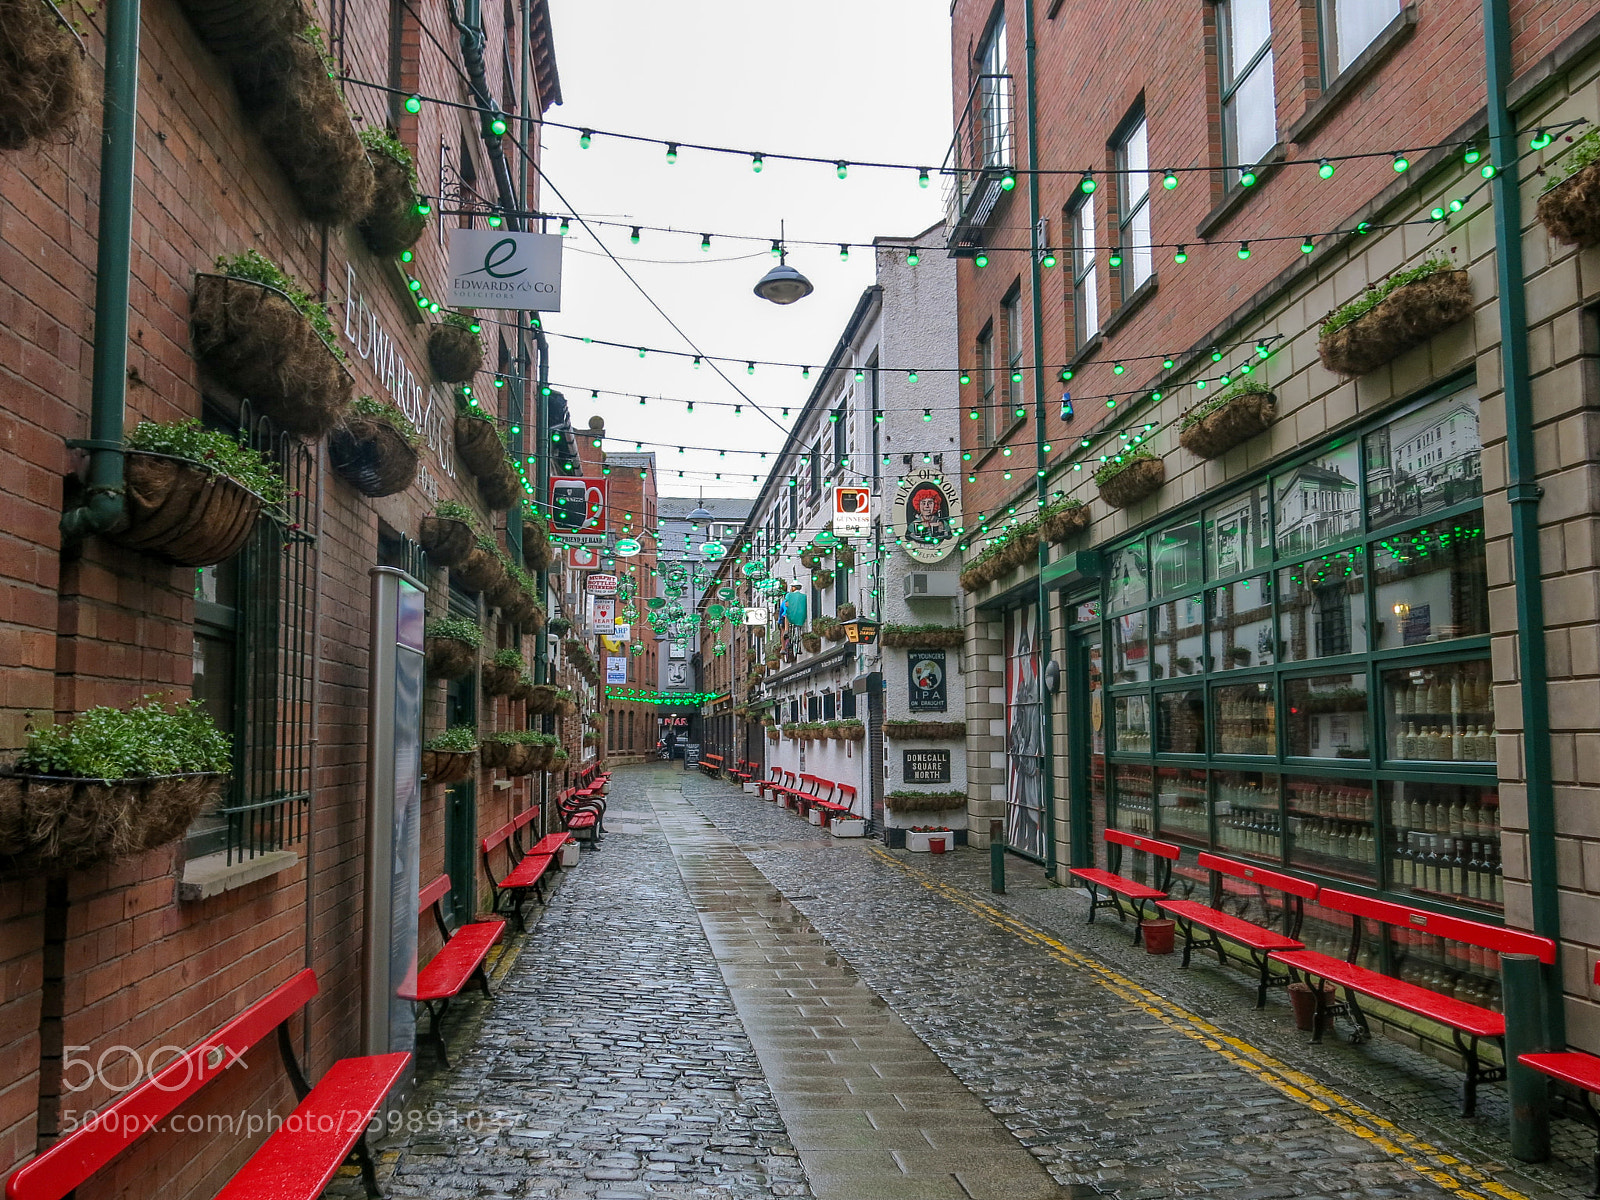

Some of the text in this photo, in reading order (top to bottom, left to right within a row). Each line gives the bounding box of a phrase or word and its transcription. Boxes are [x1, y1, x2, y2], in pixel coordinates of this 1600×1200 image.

[454, 278, 515, 292] EDWARDS
[453, 291, 514, 299] SOLICITORS
[344, 260, 422, 435] EDWARDS
[894, 476, 918, 507] DUKE
[938, 475, 960, 507] YORK
[912, 762, 942, 770] SQUARE
[914, 771, 940, 779] NORTH
